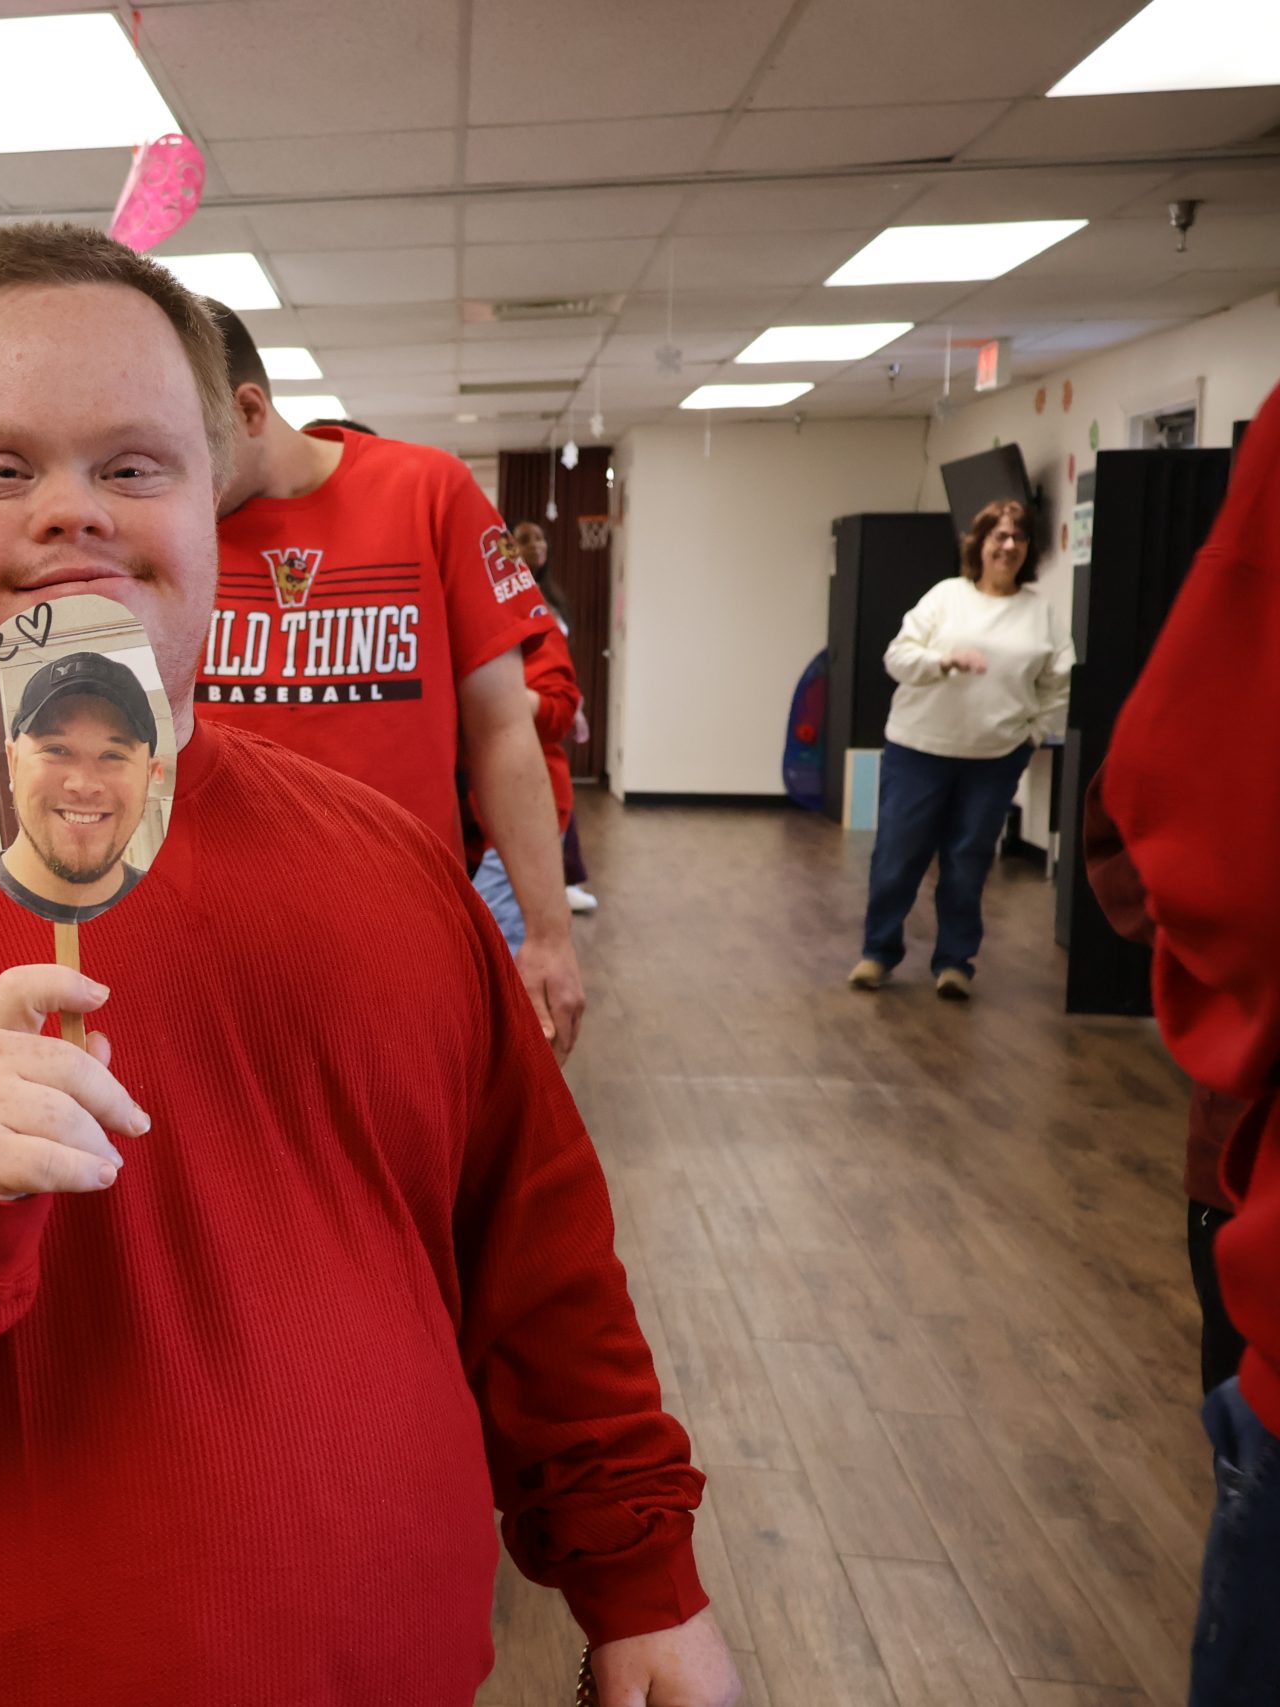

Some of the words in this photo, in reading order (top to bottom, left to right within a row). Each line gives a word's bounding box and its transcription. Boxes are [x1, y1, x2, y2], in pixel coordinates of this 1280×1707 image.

[480, 524, 528, 588] 2
[204, 609, 270, 677] ILD
[280, 605, 419, 678] THINGS
[208, 684, 383, 703] BASEBALL
